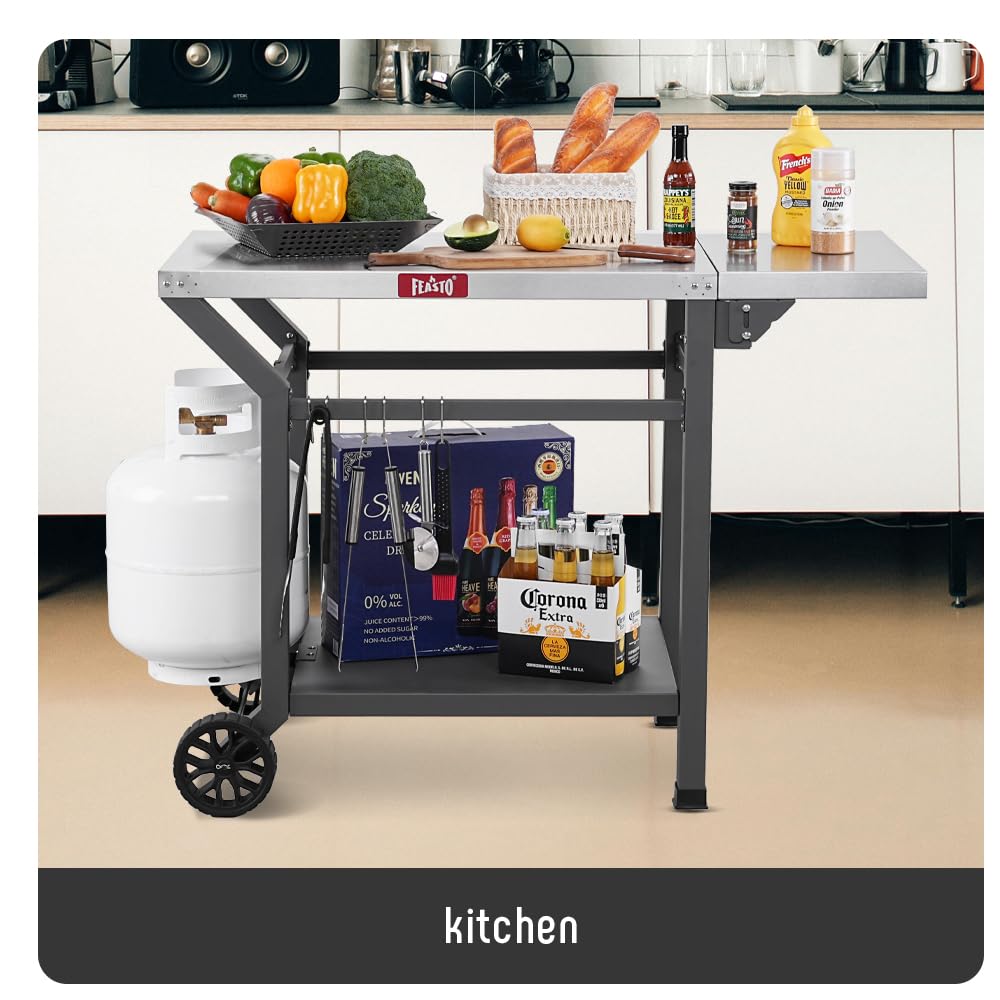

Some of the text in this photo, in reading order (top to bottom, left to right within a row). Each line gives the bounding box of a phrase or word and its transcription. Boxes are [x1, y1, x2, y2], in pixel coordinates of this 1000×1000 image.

[781, 156, 812, 171] French's
[784, 181, 807, 191] YELLOW
[822, 200, 844, 208] Onion
[398, 470, 421, 485] VEN
[461, 582, 480, 592] HEAVE
[364, 595, 388, 609] 0%
[520, 588, 587, 611] Corona
[539, 607, 574, 623] Extra
[374, 626, 396, 634] ADDED
